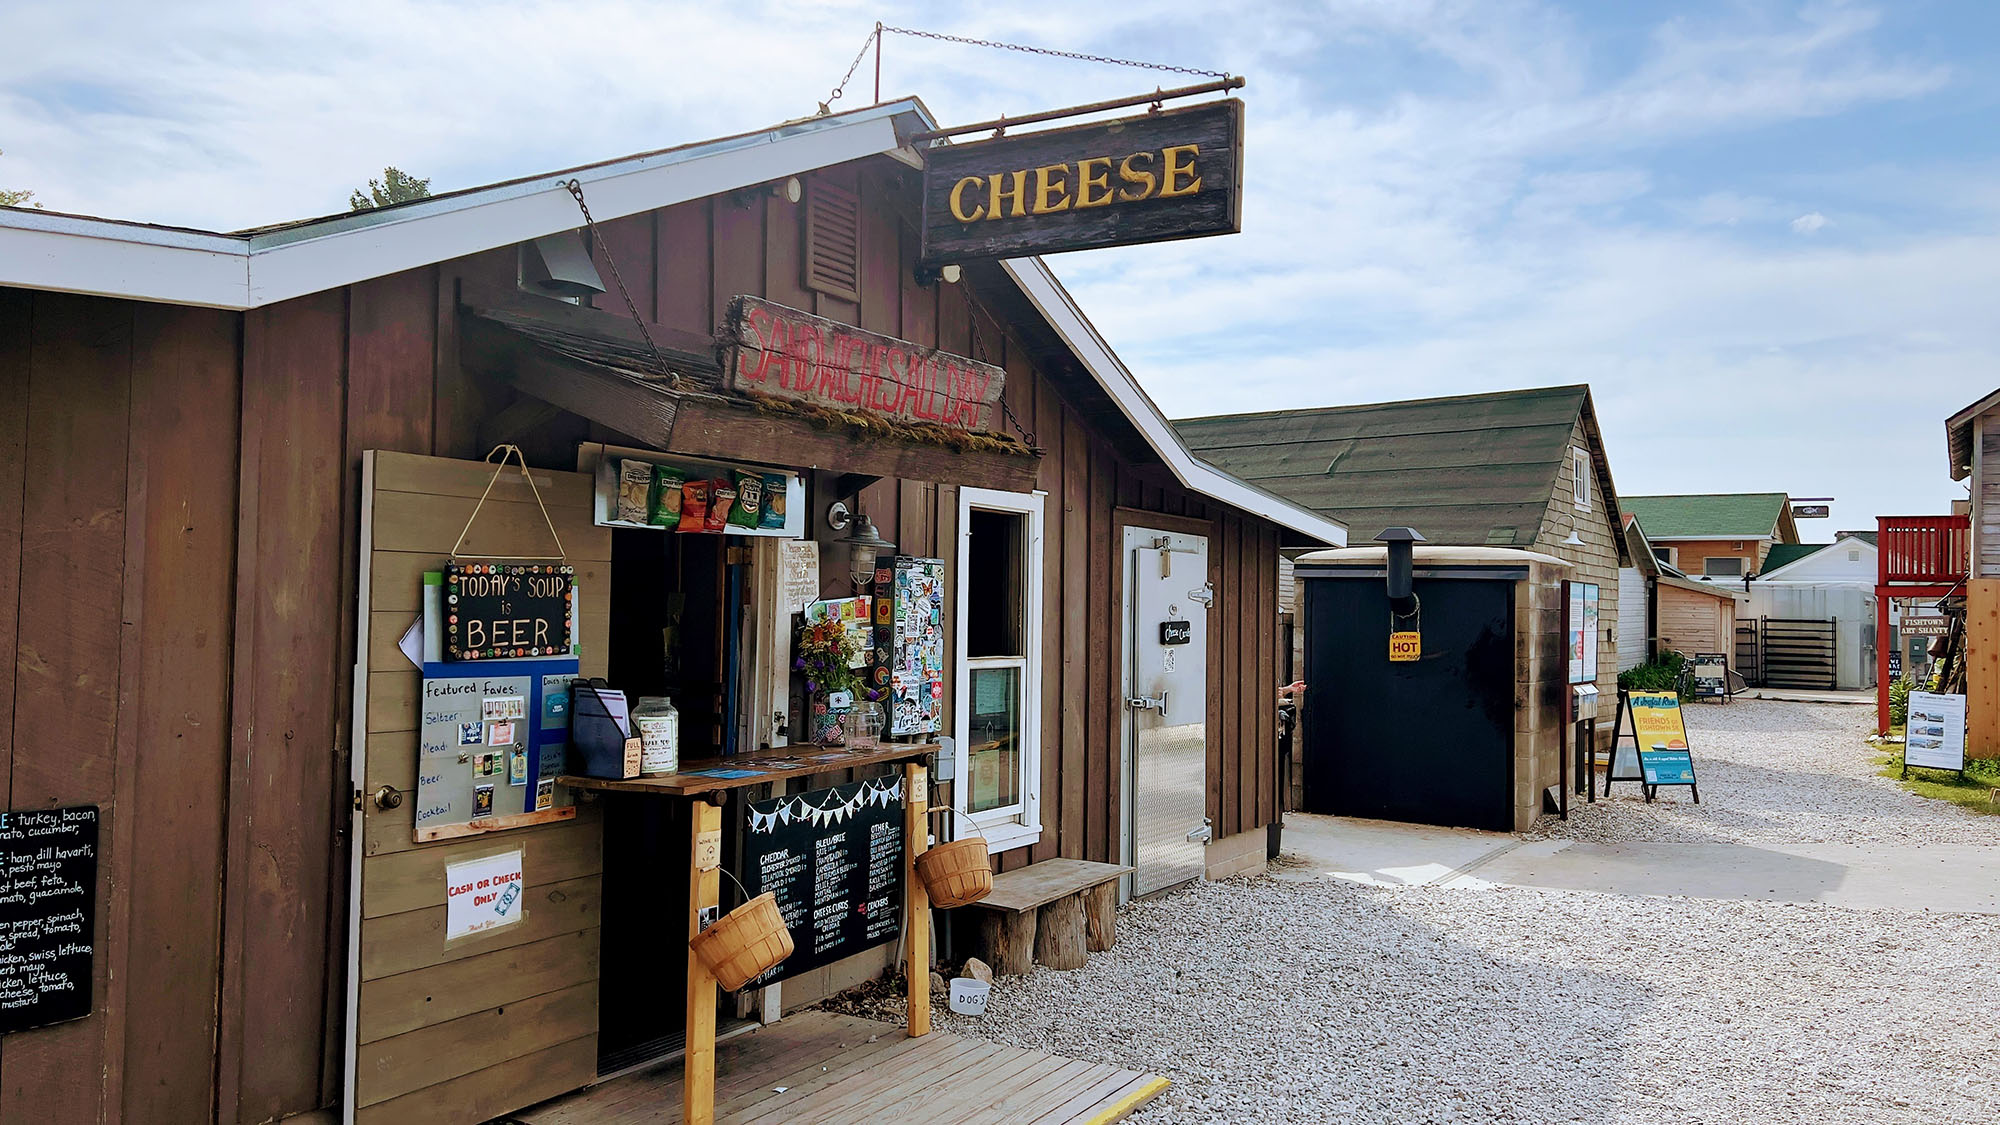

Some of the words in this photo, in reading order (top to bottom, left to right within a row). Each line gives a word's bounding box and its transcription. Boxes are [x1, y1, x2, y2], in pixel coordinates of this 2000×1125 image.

[949, 143, 1202, 224] CHEESE
[740, 308, 906, 414] SANDWICHES
[899, 353, 940, 423] ALL
[941, 363, 991, 428] DAY
[459, 574, 521, 597] TODAY'S
[527, 576, 564, 599] SOUP
[501, 600, 512, 615] is
[467, 618, 549, 649] BEER
[1392, 642, 1418, 653] HOT
[1638, 717, 1670, 725] FRIENDS
[63, 808, 96, 822] bacon,
[28, 823, 80, 836] cucumber,
[870, 821, 889, 834] OTHER
[36, 847, 52, 860] dill
[56, 844, 94, 858] havarti,
[760, 848, 790, 866] CHEDDAR
[9, 863, 35, 878] pesto
[36, 861, 62, 873] mayo
[14, 876, 38, 890] beef,
[41, 873, 68, 887] feta,
[448, 882, 473, 897] CASH
[492, 871, 521, 887] CHECK
[473, 891, 498, 907] ONLY
[813, 904, 832, 920] CHEESE
[13, 919, 44, 933] pepper,
[47, 908, 85, 927] spinach,
[9, 927, 40, 944] spread,
[43, 922, 81, 935] tomato,
[28, 949, 57, 962] swiss,
[59, 942, 93, 955] lettuce,
[20, 963, 46, 977] mayo
[38, 980, 75, 993] tomato,
[2, 993, 39, 1010] mustard
[959, 994, 986, 1006] DOG'S
